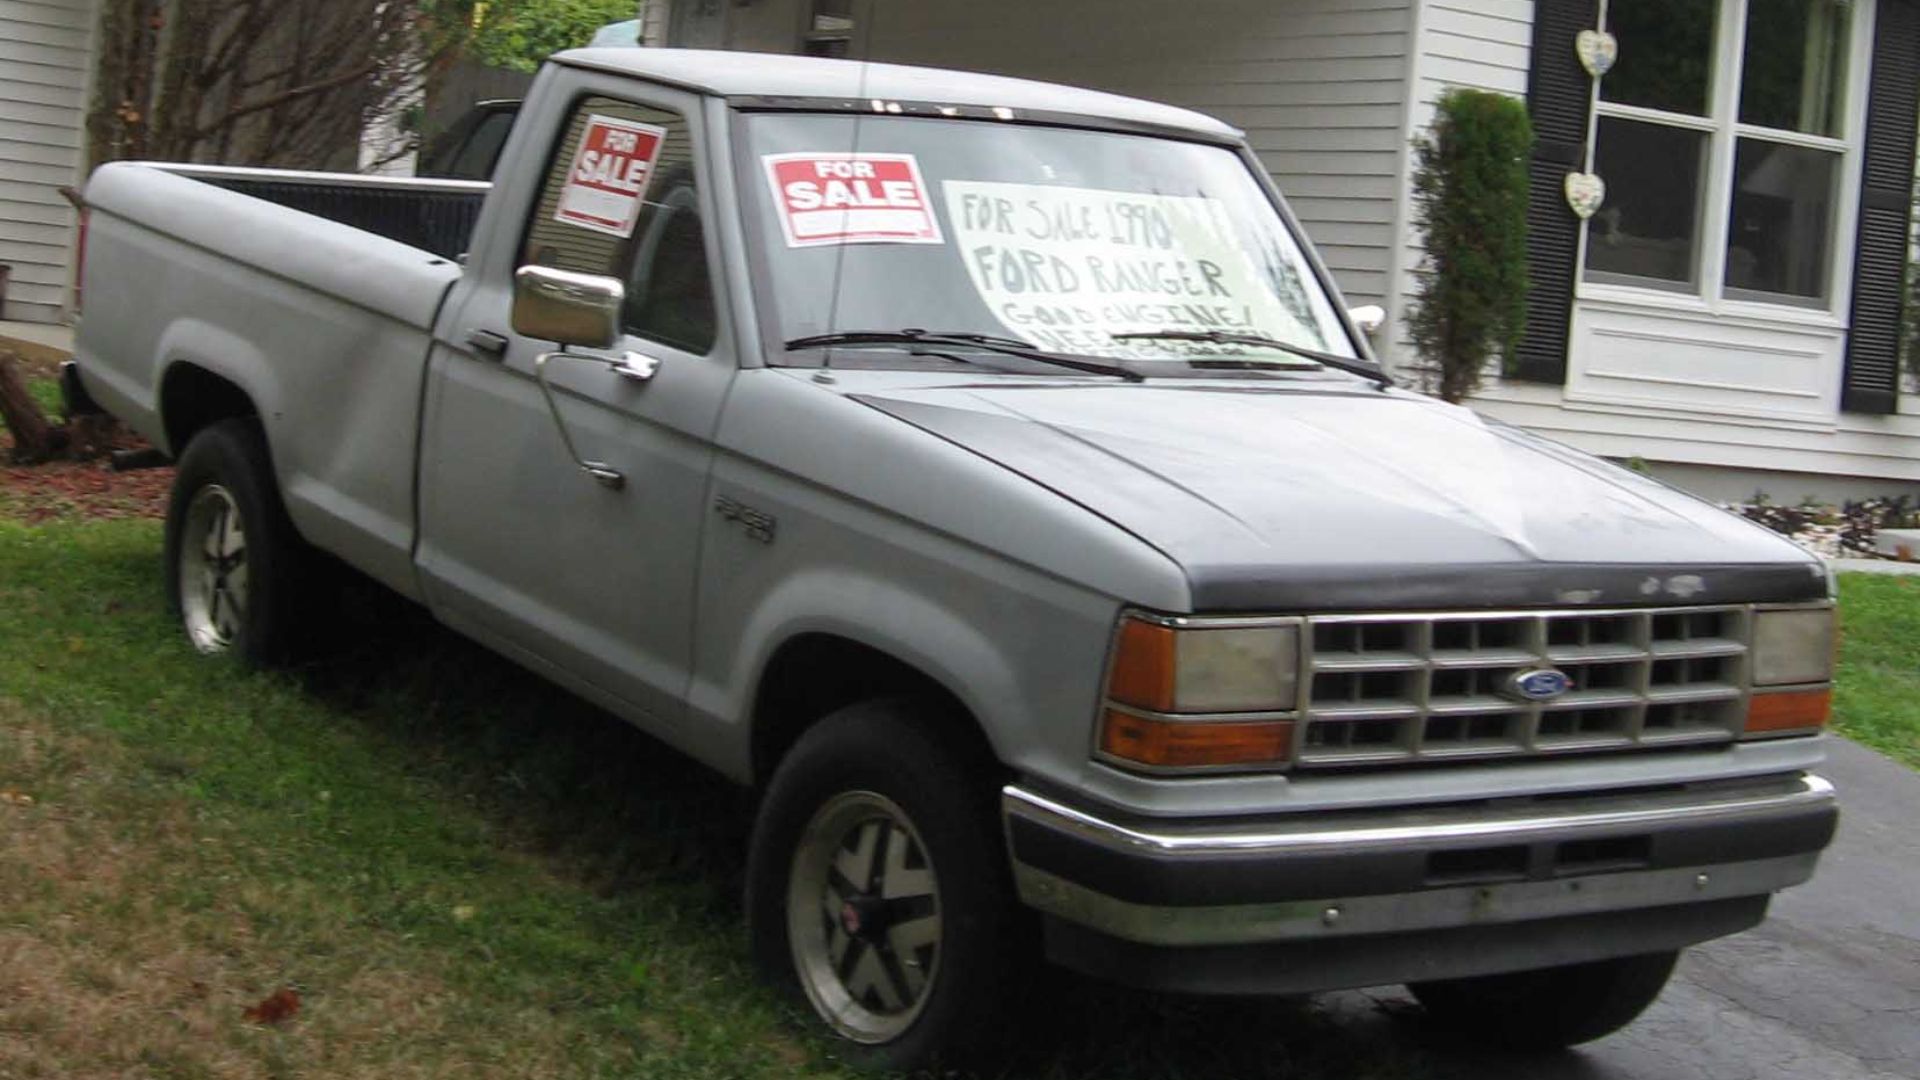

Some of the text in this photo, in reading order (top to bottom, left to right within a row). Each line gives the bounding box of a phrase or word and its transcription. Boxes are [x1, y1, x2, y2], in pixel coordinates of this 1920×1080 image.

[603, 129, 639, 153] FOR
[577, 150, 650, 193] SALE
[814, 160, 876, 178] FOR
[785, 180, 921, 209] SALE
[961, 194, 1174, 249] FOR SALE 1990
[973, 246, 1232, 297] FORD RANGER
[1003, 303, 1097, 326] GOOD
